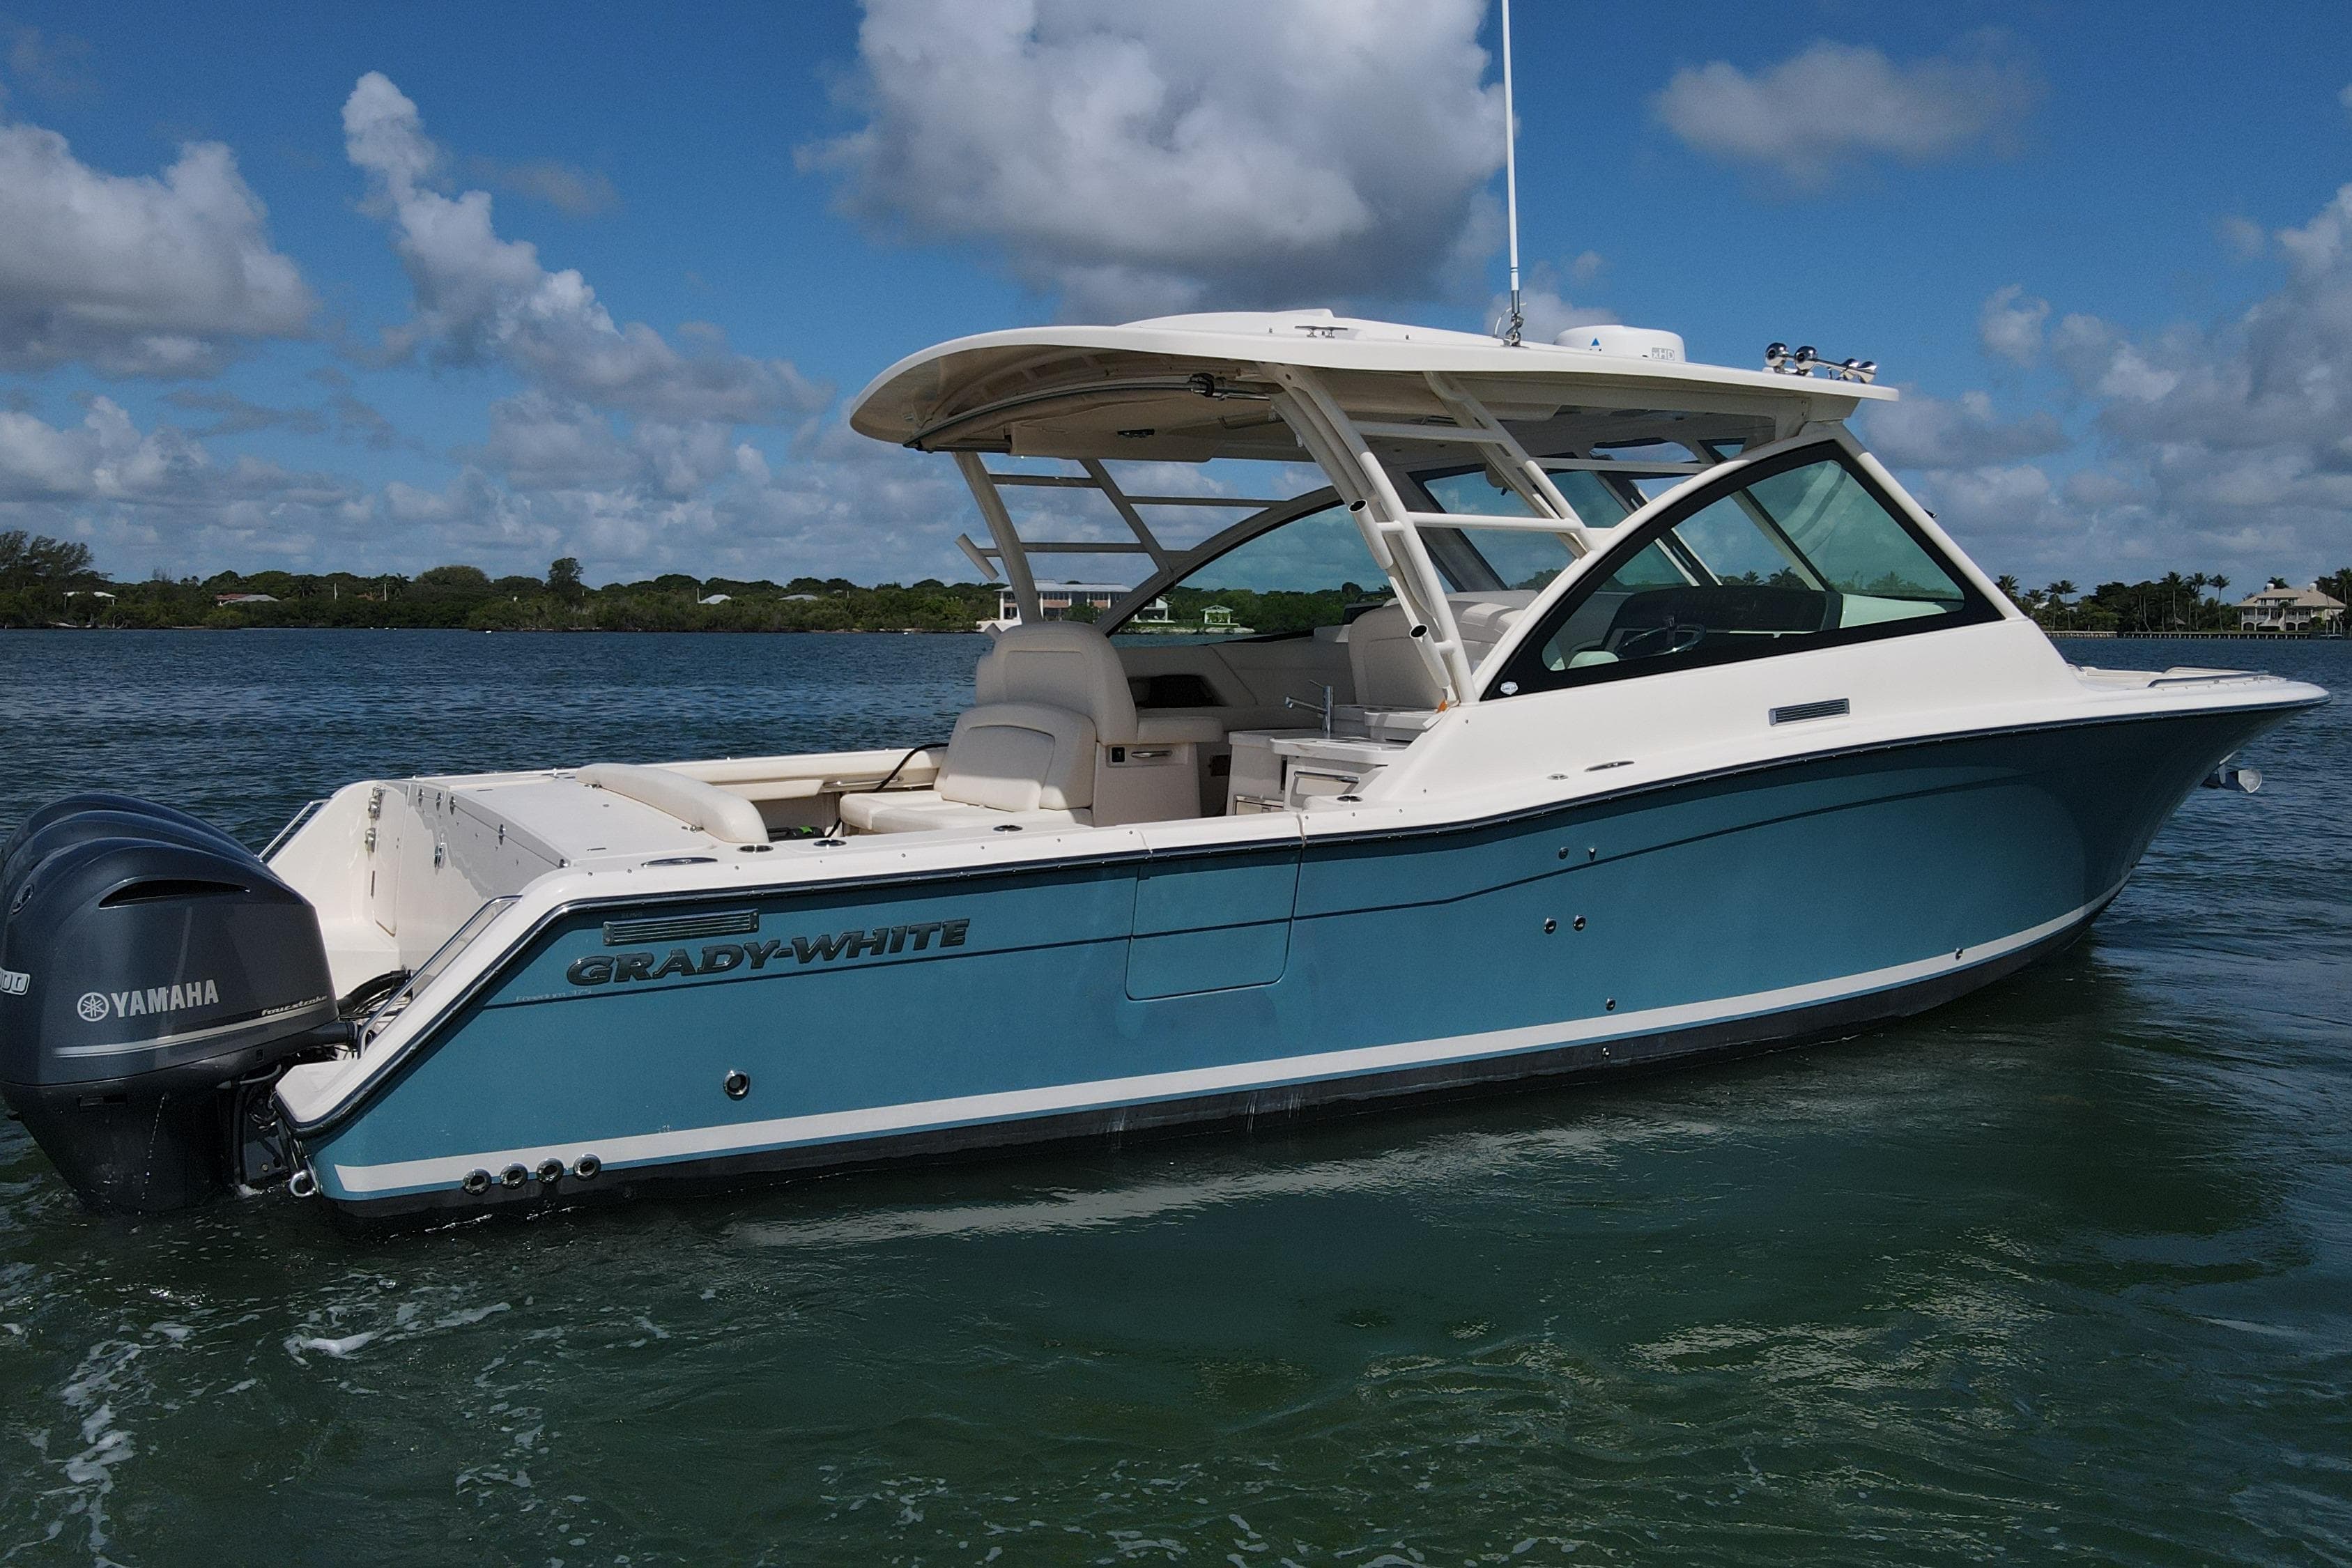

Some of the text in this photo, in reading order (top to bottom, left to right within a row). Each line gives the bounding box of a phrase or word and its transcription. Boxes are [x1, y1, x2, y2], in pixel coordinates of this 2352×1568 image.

[567, 918, 969, 985] GRADY-WHITE
[0, 969, 29, 994] 00
[110, 979, 219, 1018] YAMAHA
